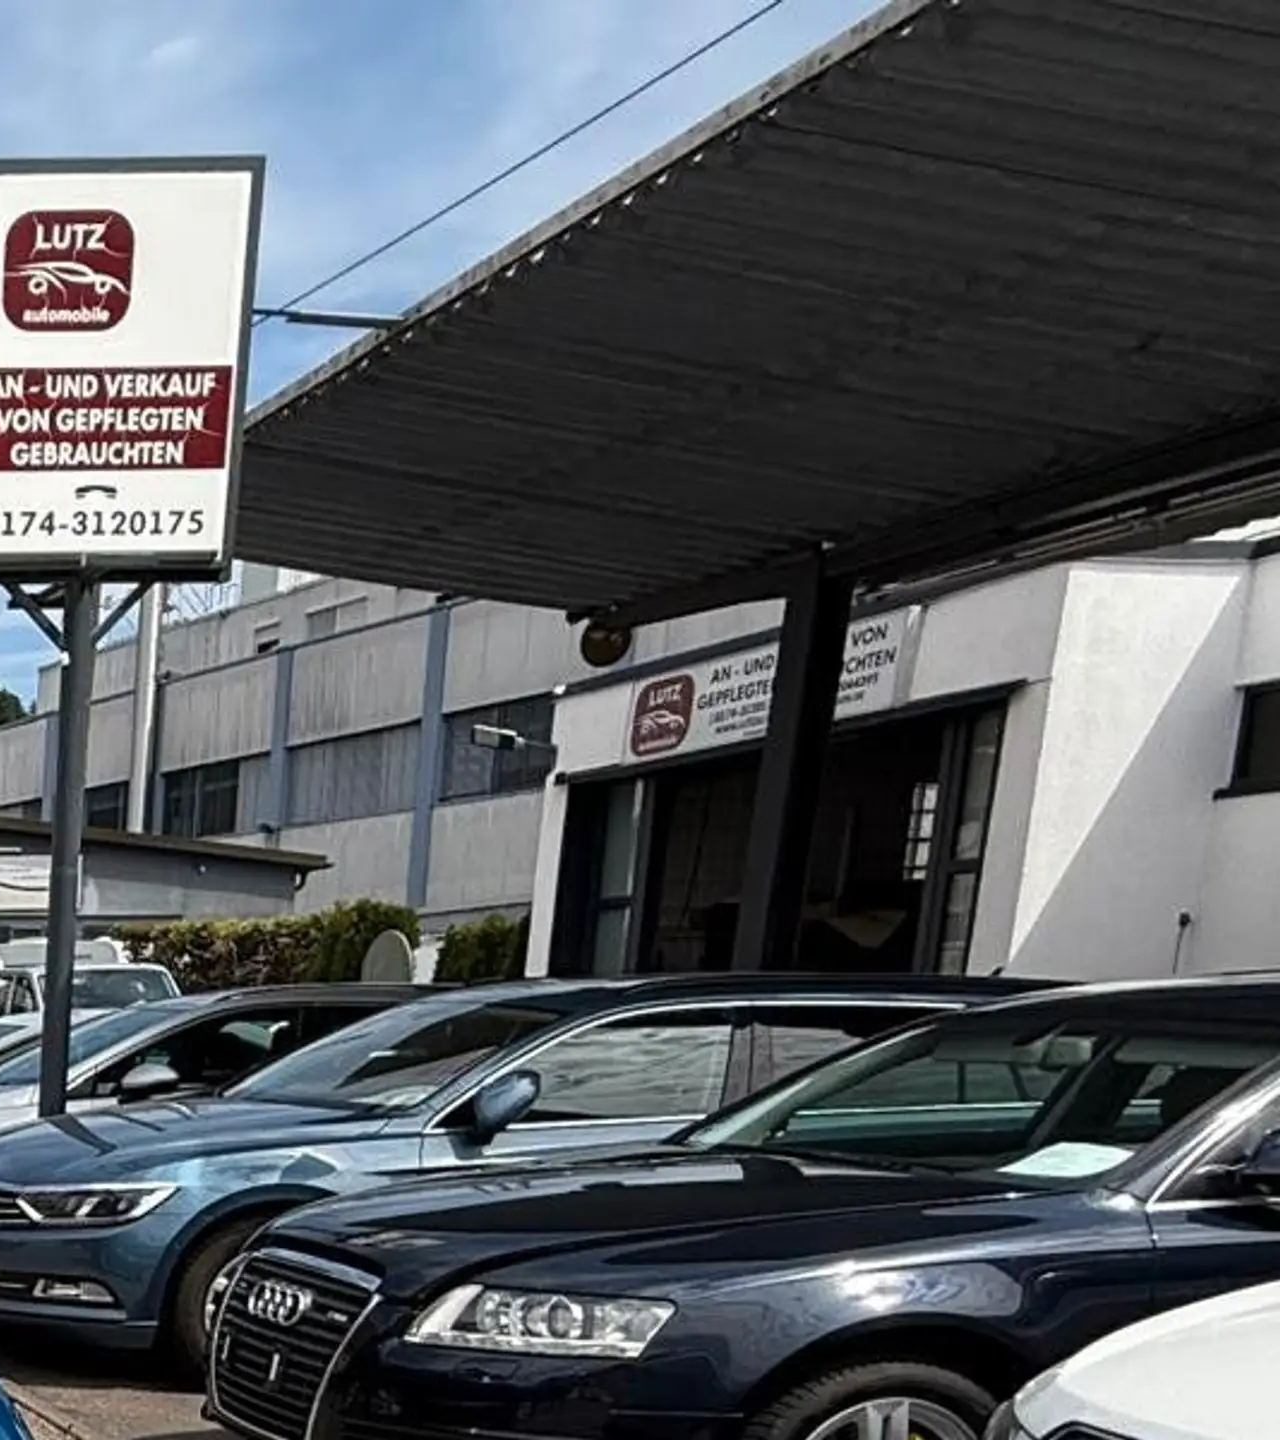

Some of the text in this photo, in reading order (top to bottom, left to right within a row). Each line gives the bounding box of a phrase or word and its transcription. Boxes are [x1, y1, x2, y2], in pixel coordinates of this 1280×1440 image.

[36, 223, 107, 250] LUTZ
[22, 308, 110, 324] automobile
[45, 375, 99, 399] UND
[104, 372, 217, 398] VERKAUF
[55, 405, 205, 432] GEPFLEGTEN
[10, 441, 185, 467] GEBRAUCHTEN
[743, 653, 775, 675] UND
[852, 622, 888, 647] VON
[696, 679, 770, 710] GEPFLEGTE
